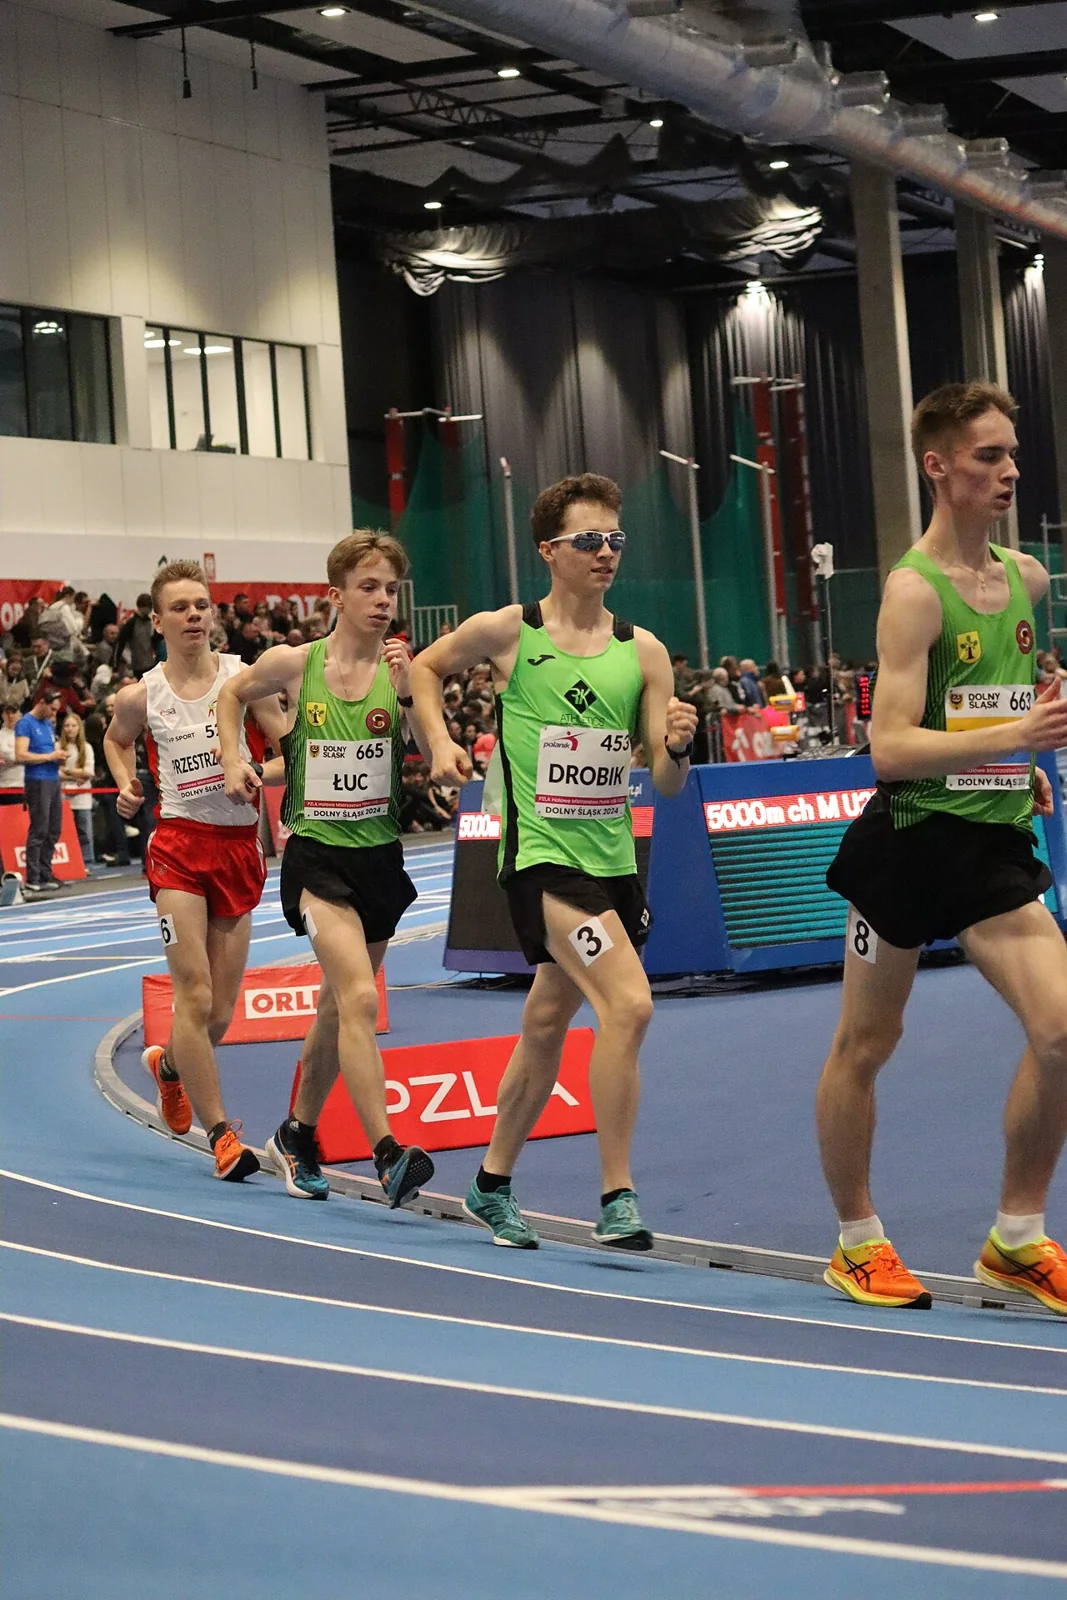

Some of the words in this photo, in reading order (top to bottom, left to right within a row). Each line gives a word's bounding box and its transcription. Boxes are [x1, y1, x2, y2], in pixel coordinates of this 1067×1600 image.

[968, 693, 1000, 701] DOLNY
[968, 700, 999, 710] ŚLĄSK
[1010, 691, 1032, 711] 663
[175, 732, 195, 742] SPORT
[205, 723, 219, 739] 5
[543, 741, 571, 749] polanik
[600, 734, 629, 752] 453
[322, 751, 346, 759] ŚLĄSK
[356, 743, 384, 760] 665
[332, 773, 368, 791] ŁUC
[549, 763, 625, 786] DROBIK
[958, 778, 992, 787] DOLNY
[181, 788, 203, 799] DOLNY
[342, 809, 365, 819] ŚLĄSK
[365, 807, 381, 815] 2024
[545, 806, 576, 815] DOLNY
[577, 806, 602, 818] ŚLĄSK
[602, 806, 619, 815] 2024
[707, 801, 785, 830] 5000m
[787, 797, 815, 822] ch
[816, 794, 840, 819] M
[842, 789, 877, 817] U2
[160, 917, 171, 944] 6
[854, 920, 870, 956] 8
[576, 925, 603, 958] 3
